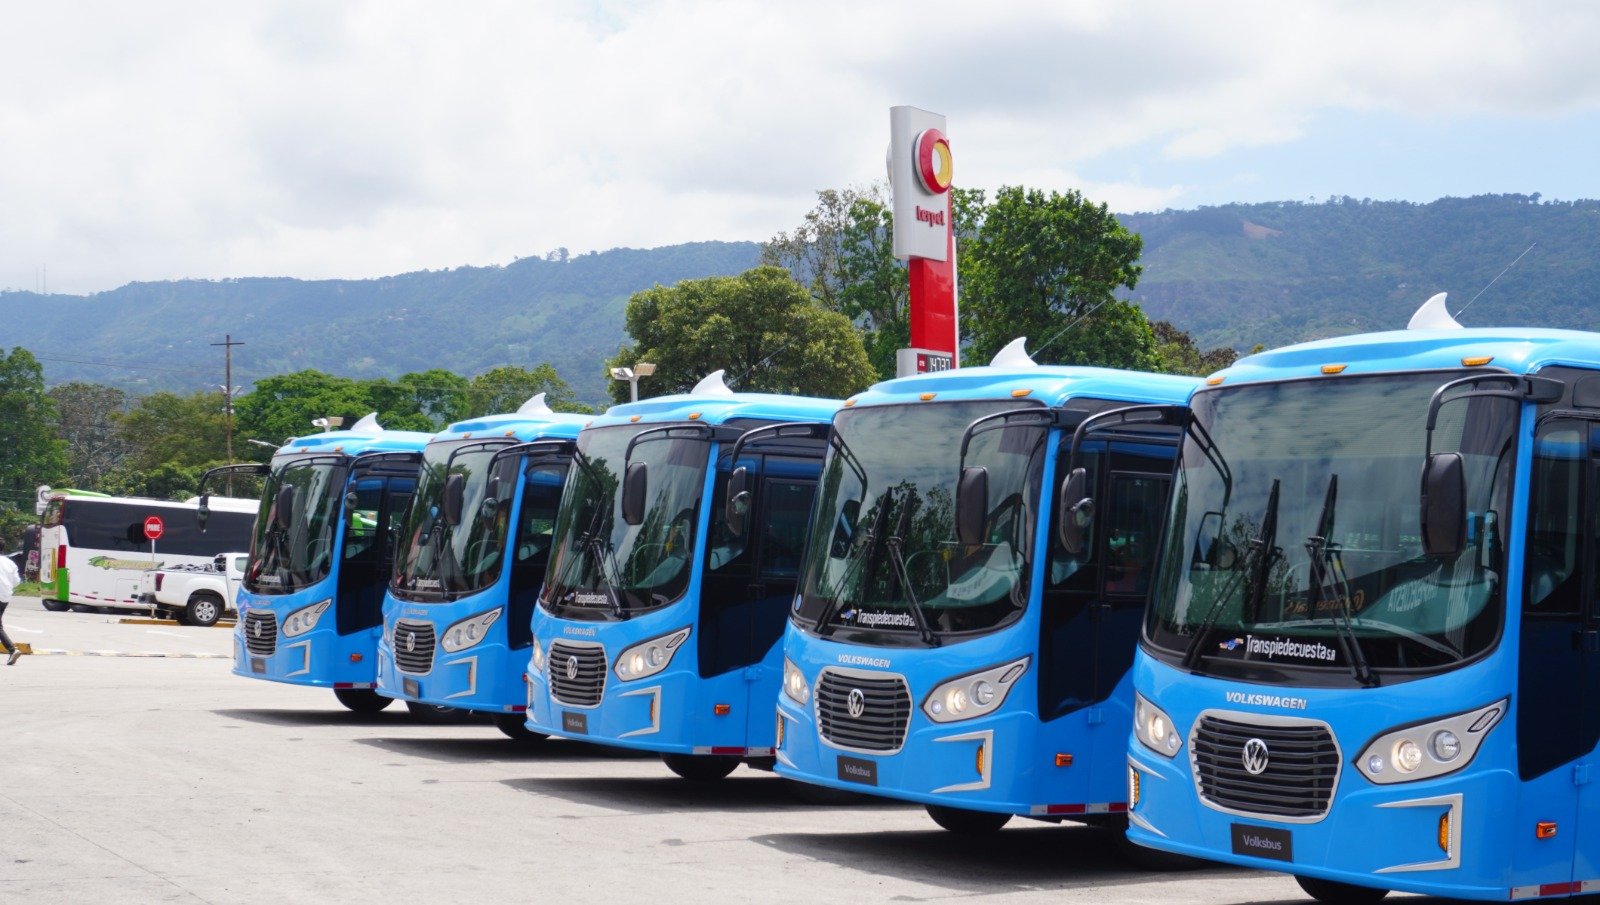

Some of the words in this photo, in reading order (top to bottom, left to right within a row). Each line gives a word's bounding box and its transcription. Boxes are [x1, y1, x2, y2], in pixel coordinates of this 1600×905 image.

[147, 524, 160, 532] PARE
[858, 608, 910, 628] Transpiedecuesta
[1246, 634, 1326, 660] Transpiedecuesta
[838, 654, 891, 669] VOLKSWAGEN
[1226, 691, 1307, 710] VOLKSWAGEN
[1243, 834, 1282, 850] Volksbus
